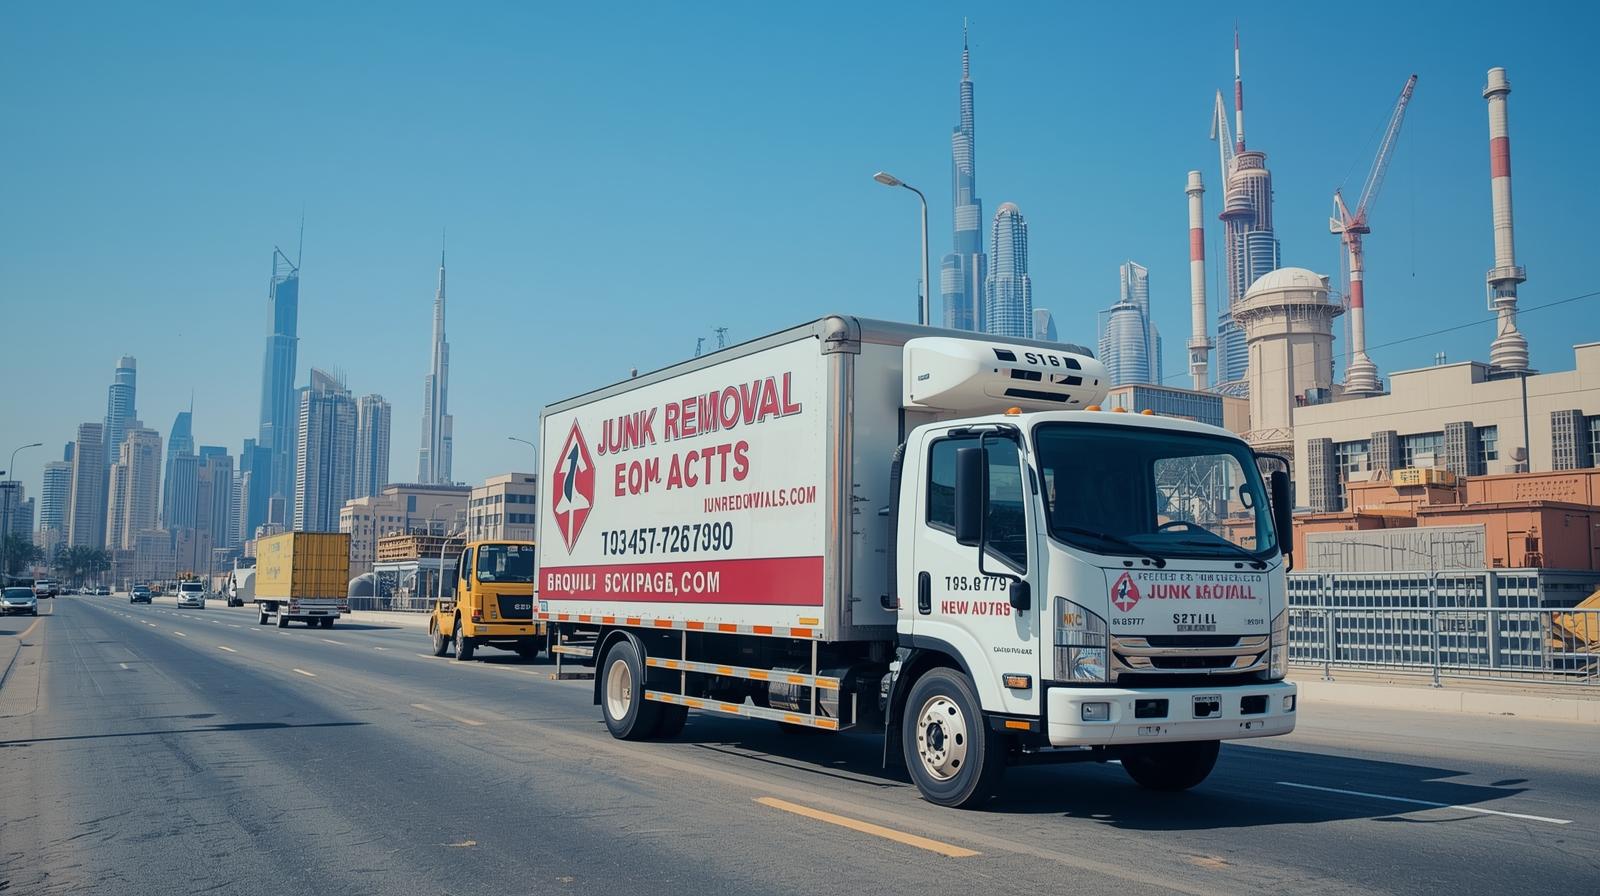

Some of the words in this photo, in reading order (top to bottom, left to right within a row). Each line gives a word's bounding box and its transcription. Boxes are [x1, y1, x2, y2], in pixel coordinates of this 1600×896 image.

[597, 407, 657, 456] JUNK
[664, 371, 802, 442] REMOVAL
[666, 440, 750, 491] ACTTS
[1147, 584, 1191, 600] JUNK
